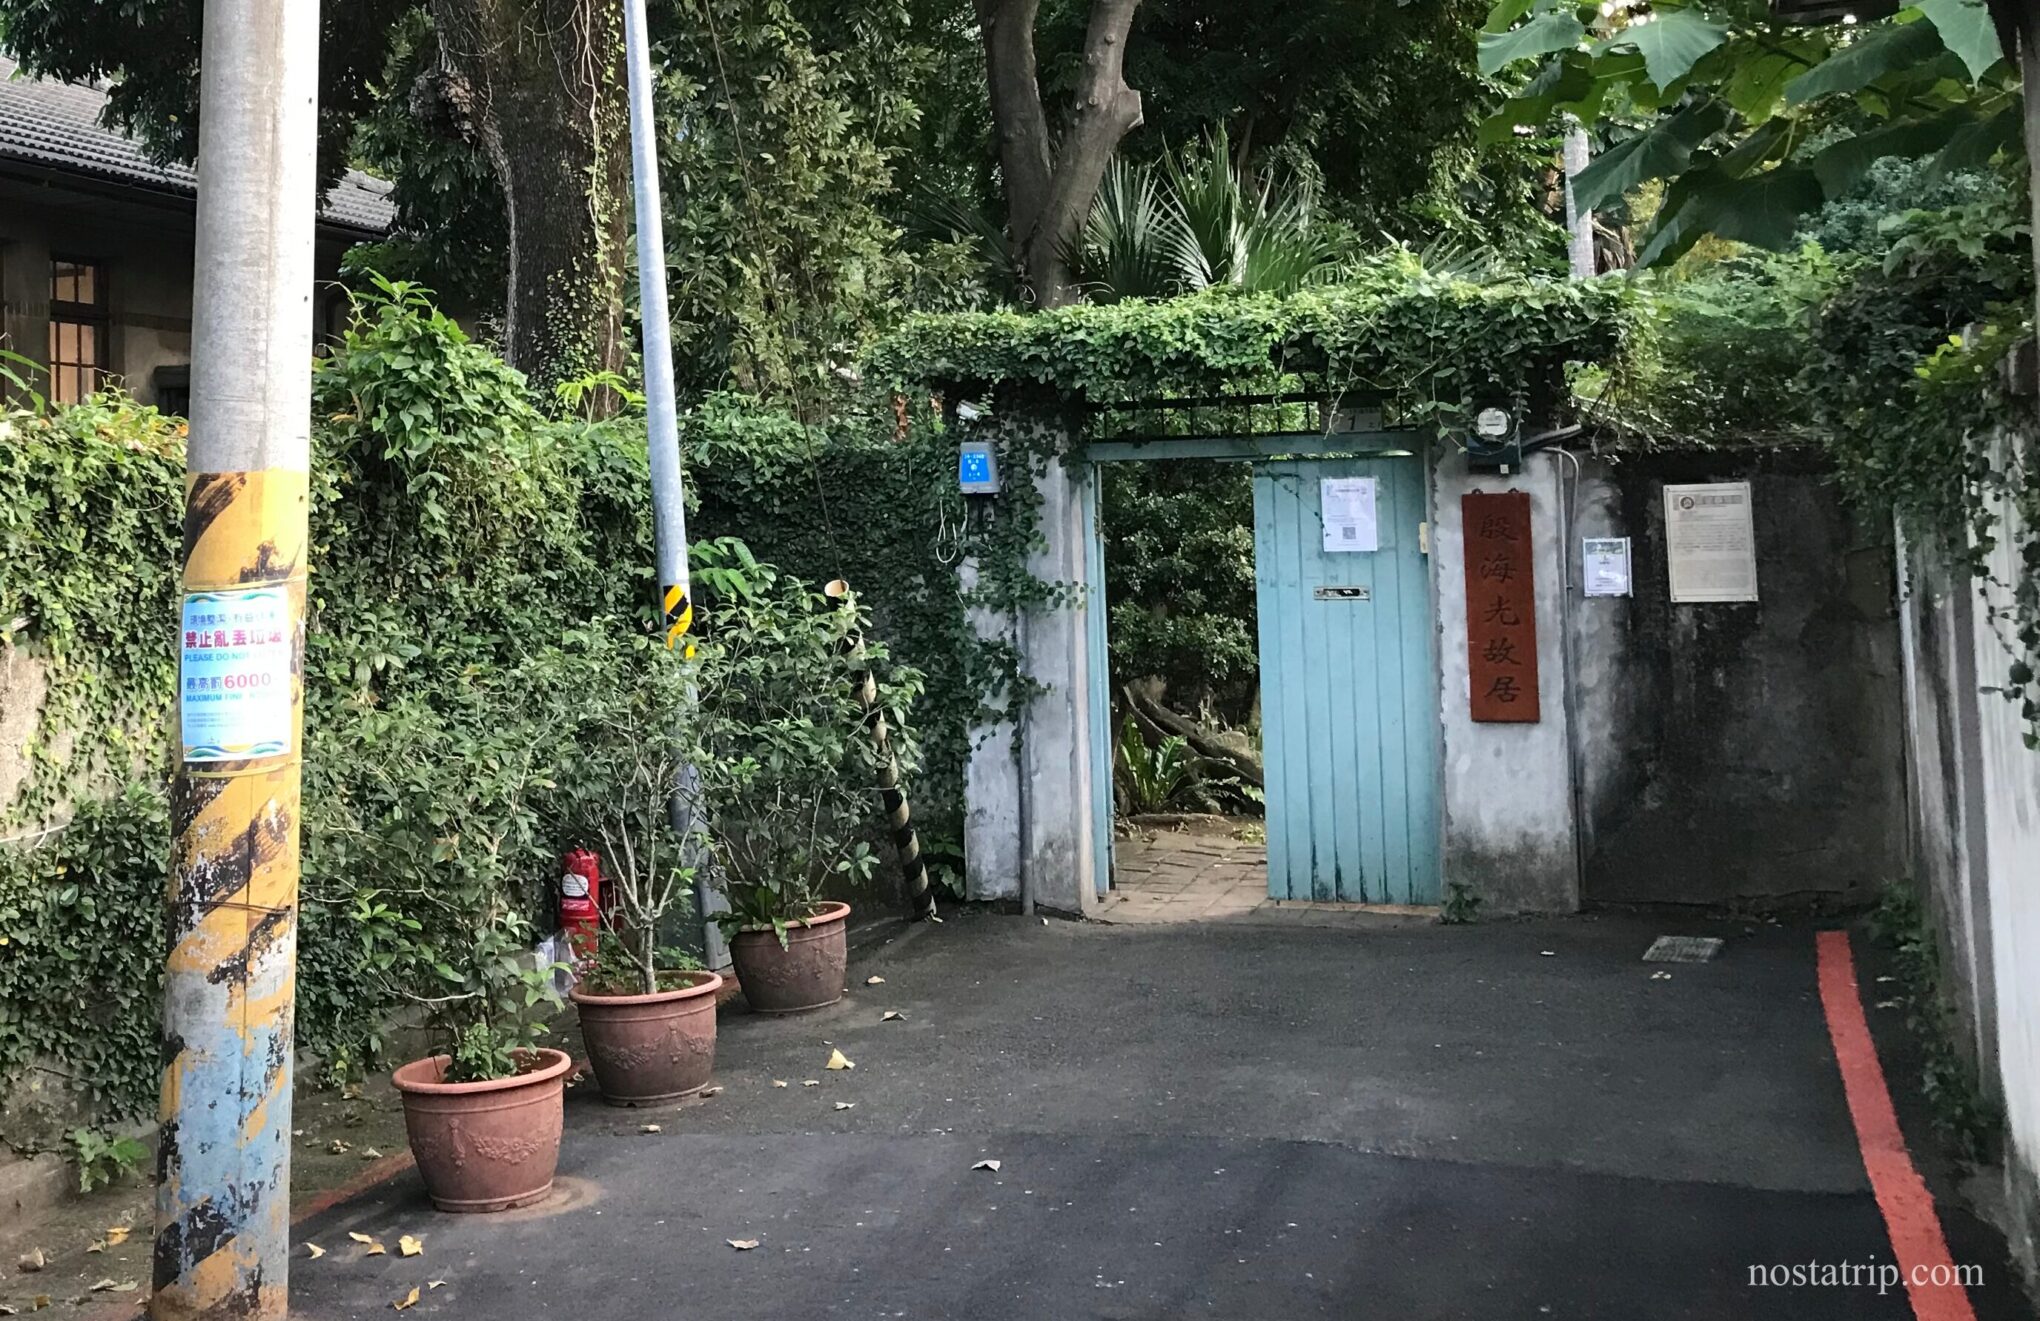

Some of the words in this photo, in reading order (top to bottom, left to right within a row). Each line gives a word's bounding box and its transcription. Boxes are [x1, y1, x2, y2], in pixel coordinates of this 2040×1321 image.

[1480, 513, 1521, 704] 殷海光故居
[185, 653, 213, 662] PLEASE
[216, 652, 229, 661] DO
[186, 694, 222, 702] MAXIMUM
